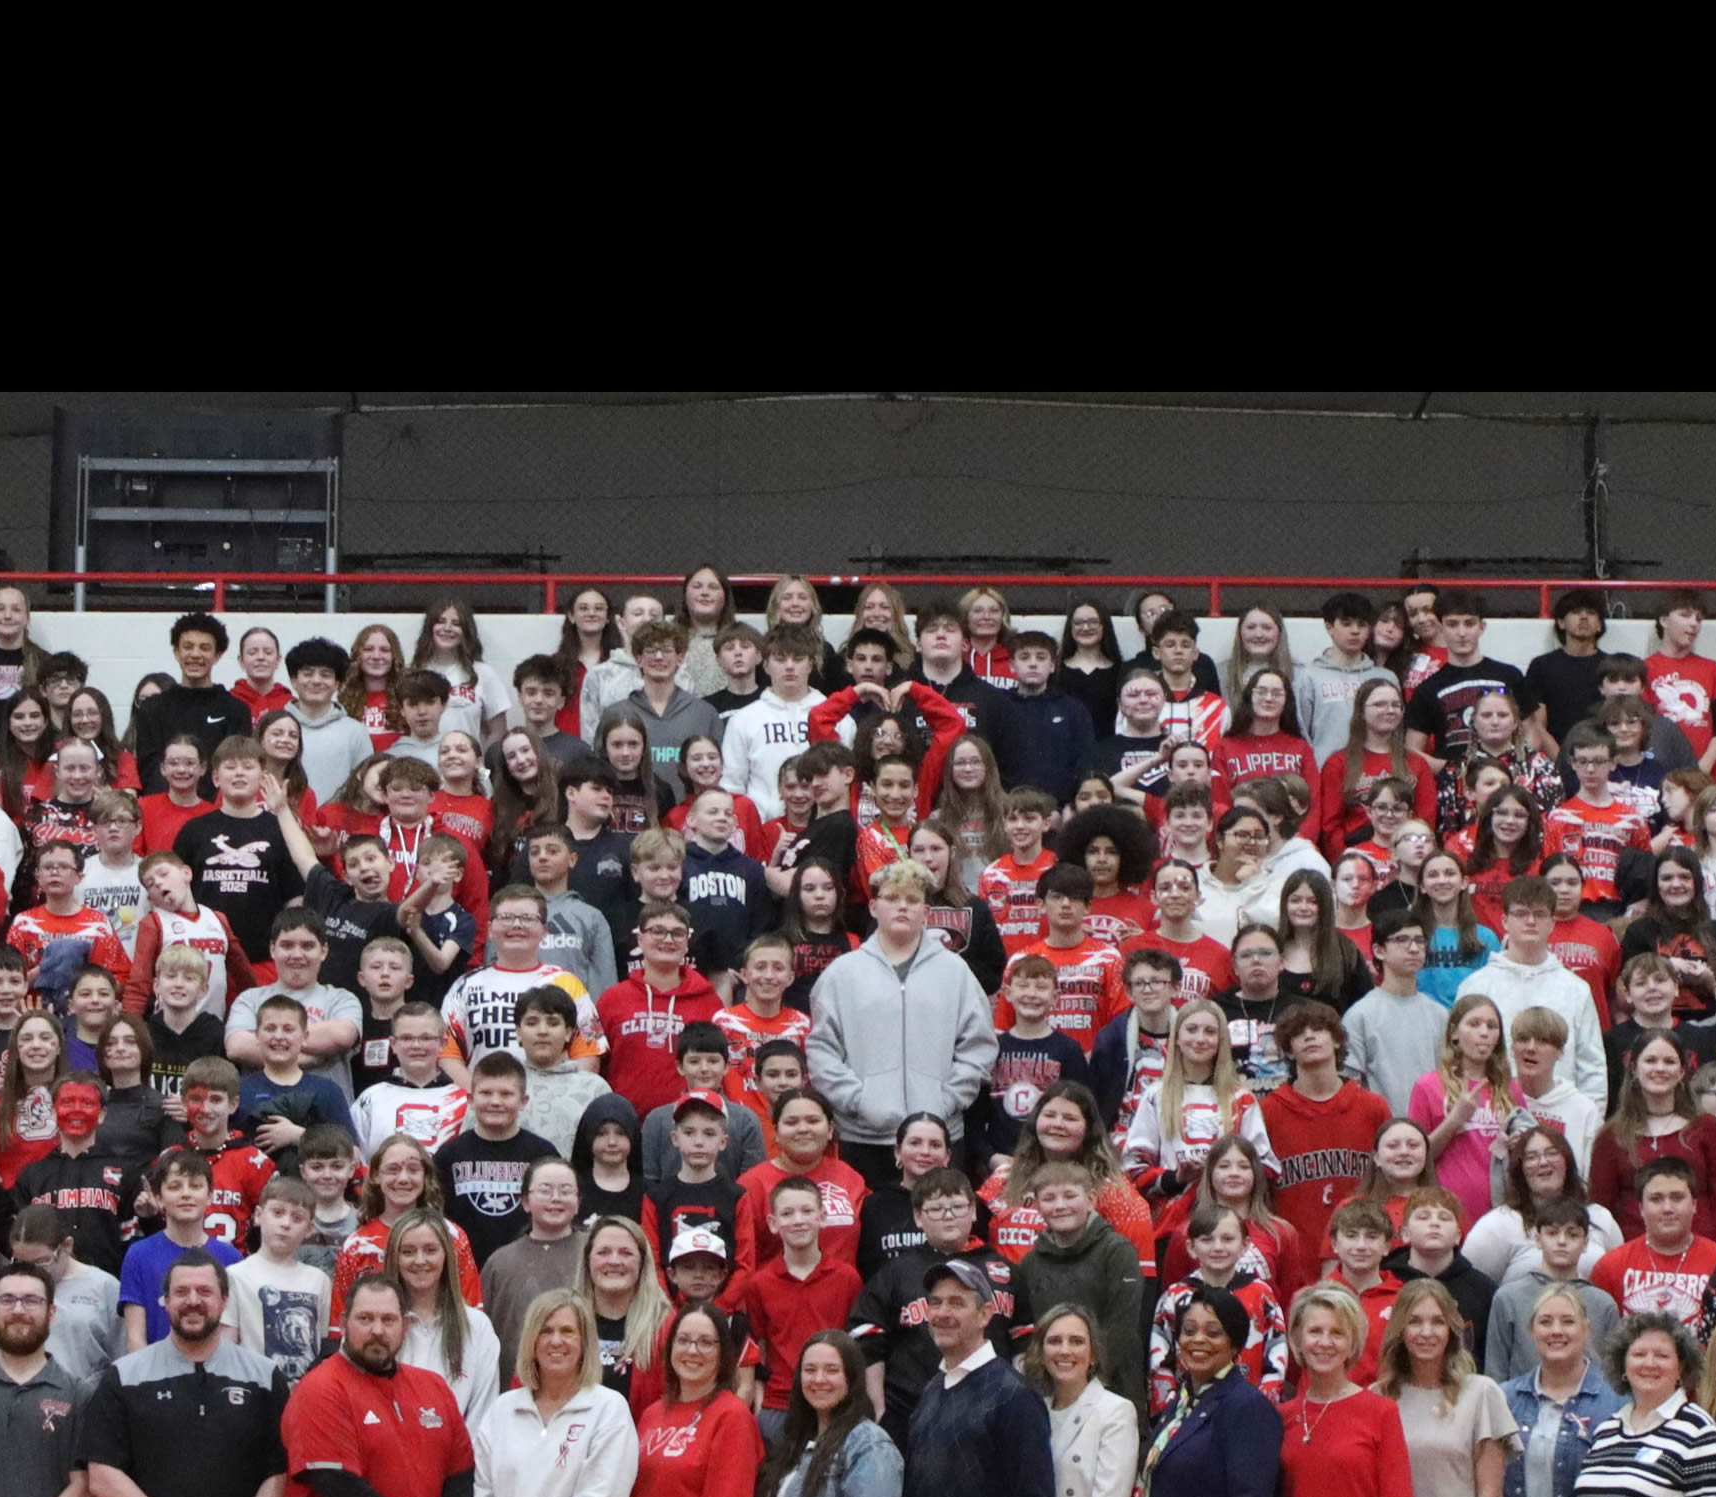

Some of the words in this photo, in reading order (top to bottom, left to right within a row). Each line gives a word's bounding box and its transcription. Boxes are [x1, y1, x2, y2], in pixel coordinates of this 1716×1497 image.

[763, 724, 810, 746] IRIS
[202, 869, 270, 884] BASKETBALL
[83, 886, 142, 901] COLUMBIANA
[688, 871, 747, 905] BOSTON
[83, 896, 109, 909] FUN
[538, 931, 584, 951] adidas
[467, 991, 521, 1006] ALMI
[467, 1006, 517, 1028] CHE
[472, 1028, 519, 1049] PUF
[1013, 1090, 1031, 1113] C
[1275, 1147, 1373, 1190] CINCINNAT
[1623, 1267, 1711, 1303] CLIPPERS
